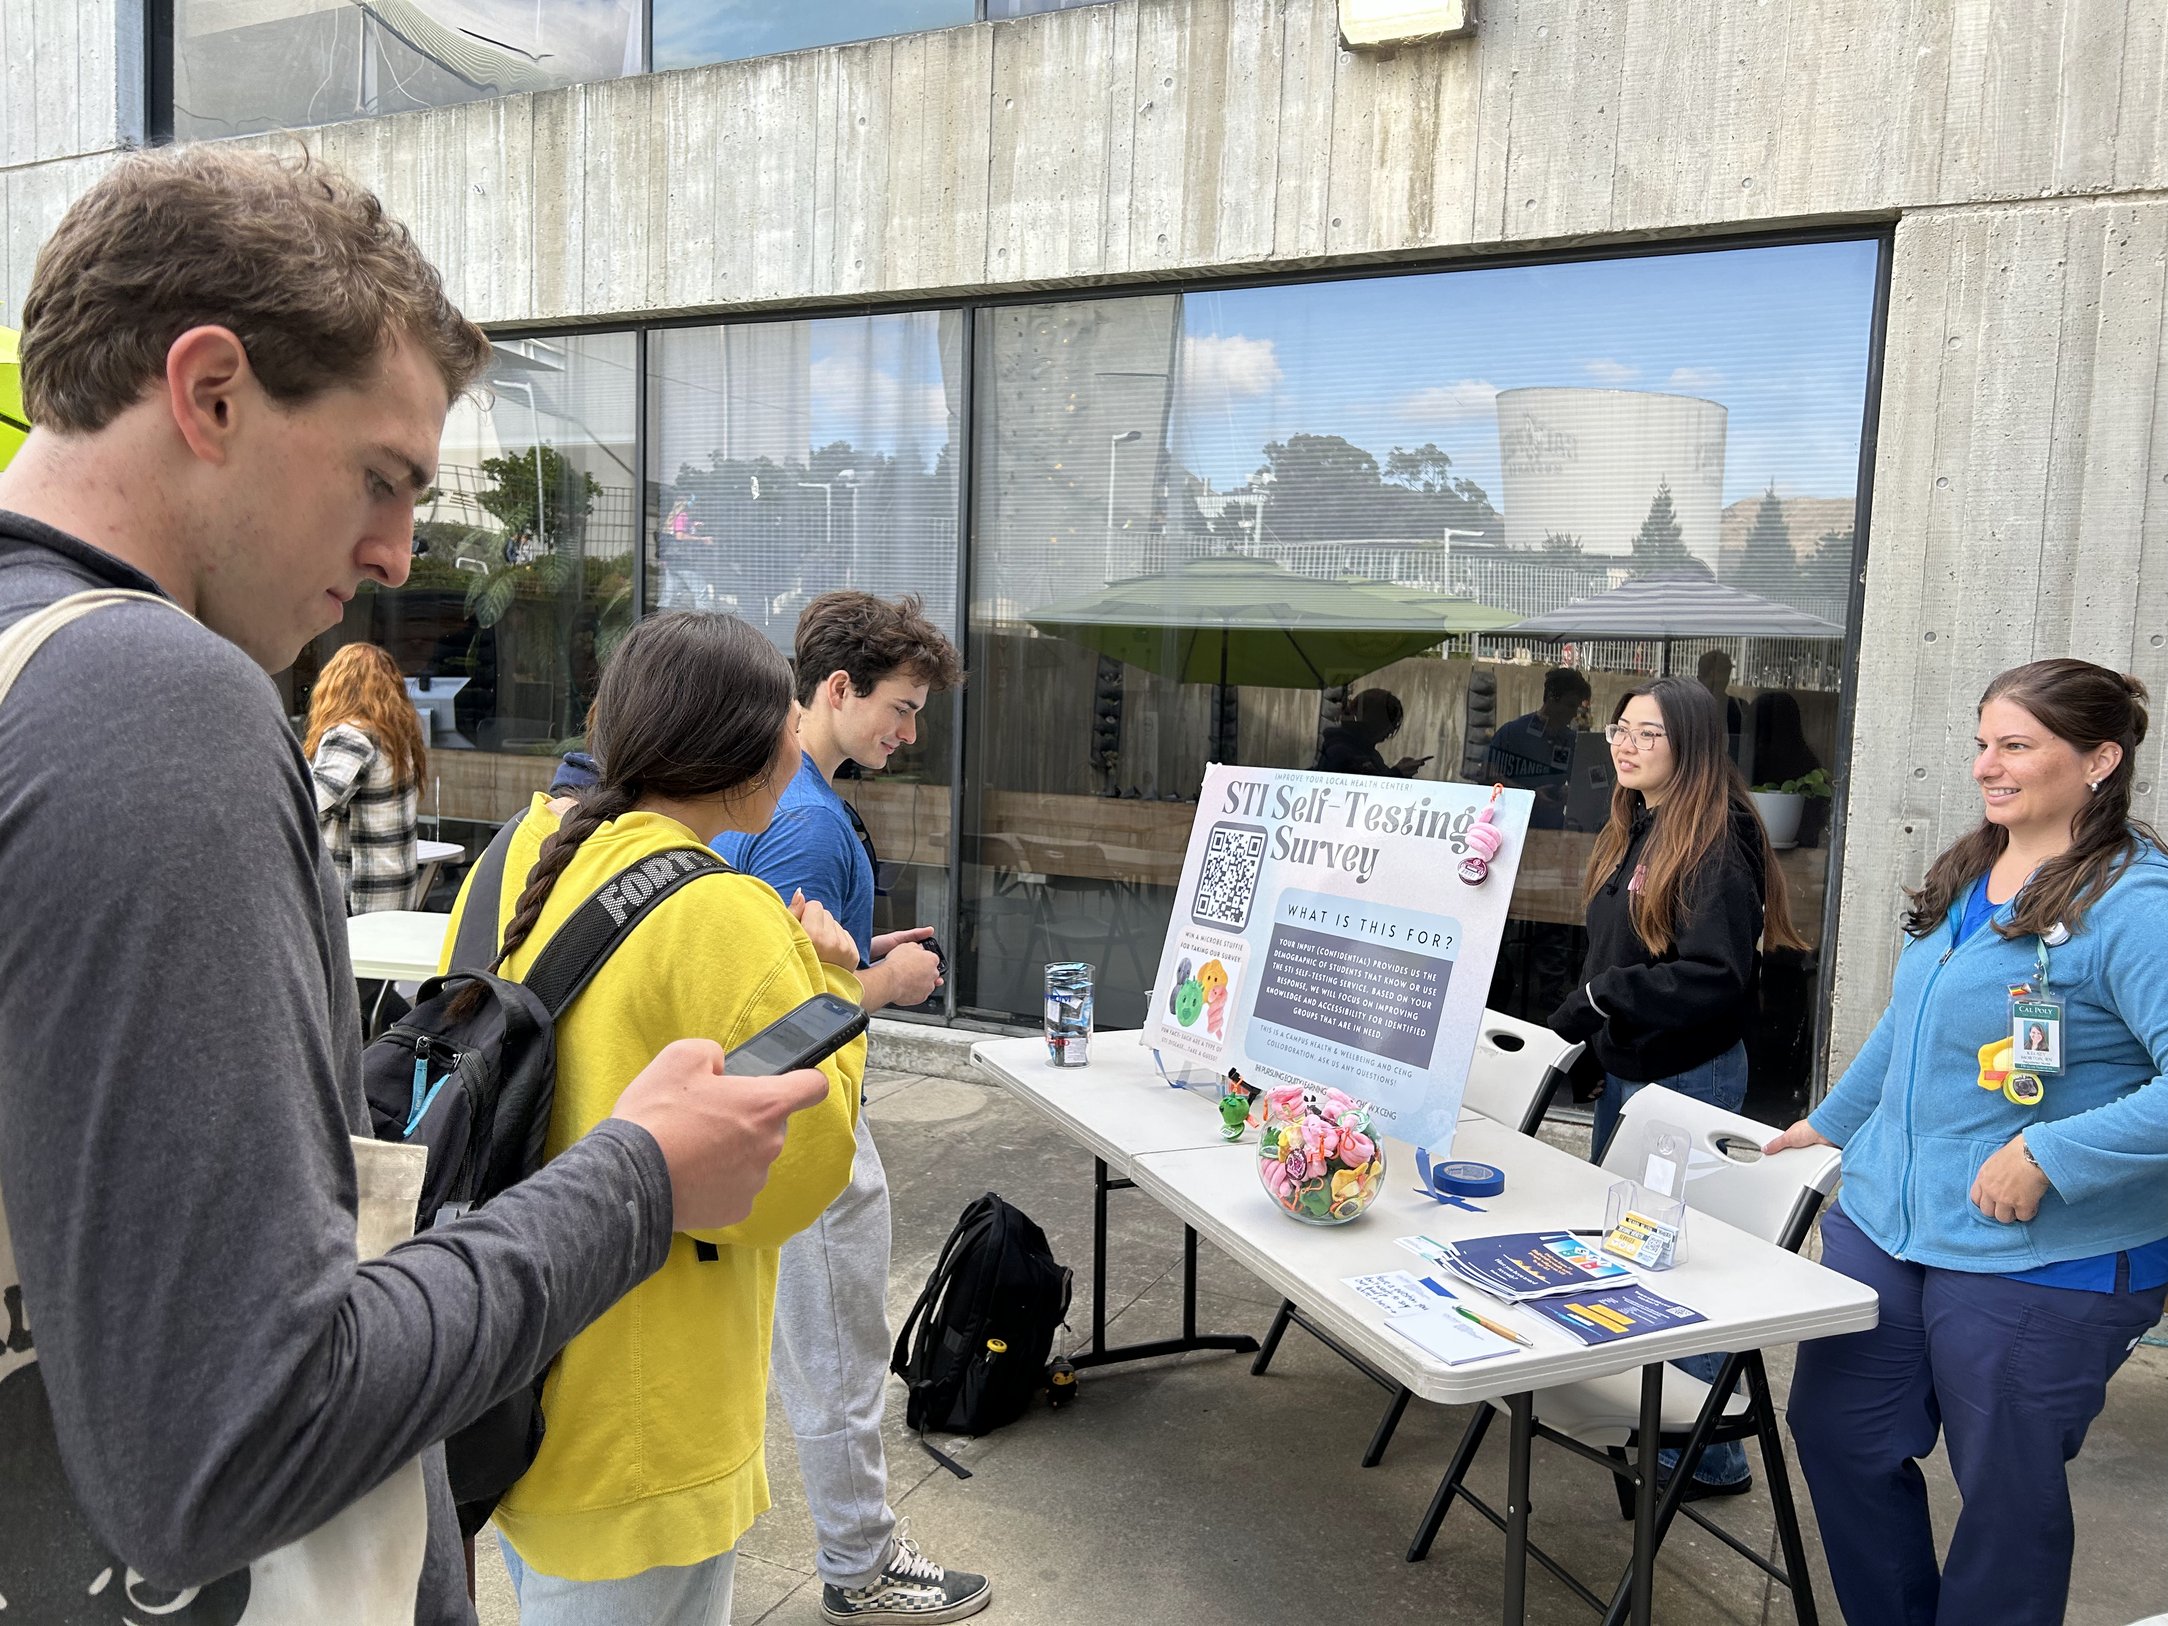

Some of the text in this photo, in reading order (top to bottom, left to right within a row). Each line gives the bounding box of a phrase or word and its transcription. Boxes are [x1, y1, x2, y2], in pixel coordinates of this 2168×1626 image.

[1274, 773, 1413, 791] IMPROVE YOUR LOCAL HEALTH CENTER!
[1222, 780, 1477, 855] STI Self-Testing
[1270, 825, 1380, 884] Survey
[596, 850, 720, 927] FORT
[1200, 935, 1222, 946] MICROBE
[1288, 904, 1453, 949] WHAT IS THIS FOR?
[1191, 945, 1209, 955] TAKING
[1280, 938, 1437, 982] YOUR INPUT (CONFIDENTIAL) PROVIDES US THE
[1272, 962, 1284, 971] THE
[1284, 964, 1294, 974] STI
[1295, 967, 1338, 985] SELF-TESTING
[1371, 987, 1395, 1000] BASED
[1396, 994, 1408, 1003] ON
[1411, 997, 1432, 1010] YOUR
[1274, 949, 1437, 997] DEMOGRAPHIC OF STUDENTS THAT KNOW OR USE
[1266, 986, 1427, 1037] KNOWLEDGE AND ACCESSIBILITY FOR IDENTIFIED
[1277, 976, 1419, 1021] RESPONSE, WE WILL FOCUS ON IMPROVING
[2019, 1005, 2053, 1014] CAL POLY
[1293, 1007, 1383, 1040] GROUPS THAT ARE IN NEED.
[1260, 1024, 1272, 1034] THIS
[1285, 1032, 1309, 1046] CAMPUS
[1309, 1040, 1332, 1052] HEALTH
[1340, 1049, 1376, 1067] WELLBEING
[1377, 1062, 1392, 1072] AND
[1393, 1066, 1413, 1078] CENG
[1317, 1056, 1330, 1065] ASK
[1331, 1060, 1339, 1068] US
[1341, 1063, 1355, 1073] ANY
[1356, 1068, 1397, 1086] QUESTIONS!
[1379, 1107, 1397, 1120] CENG
